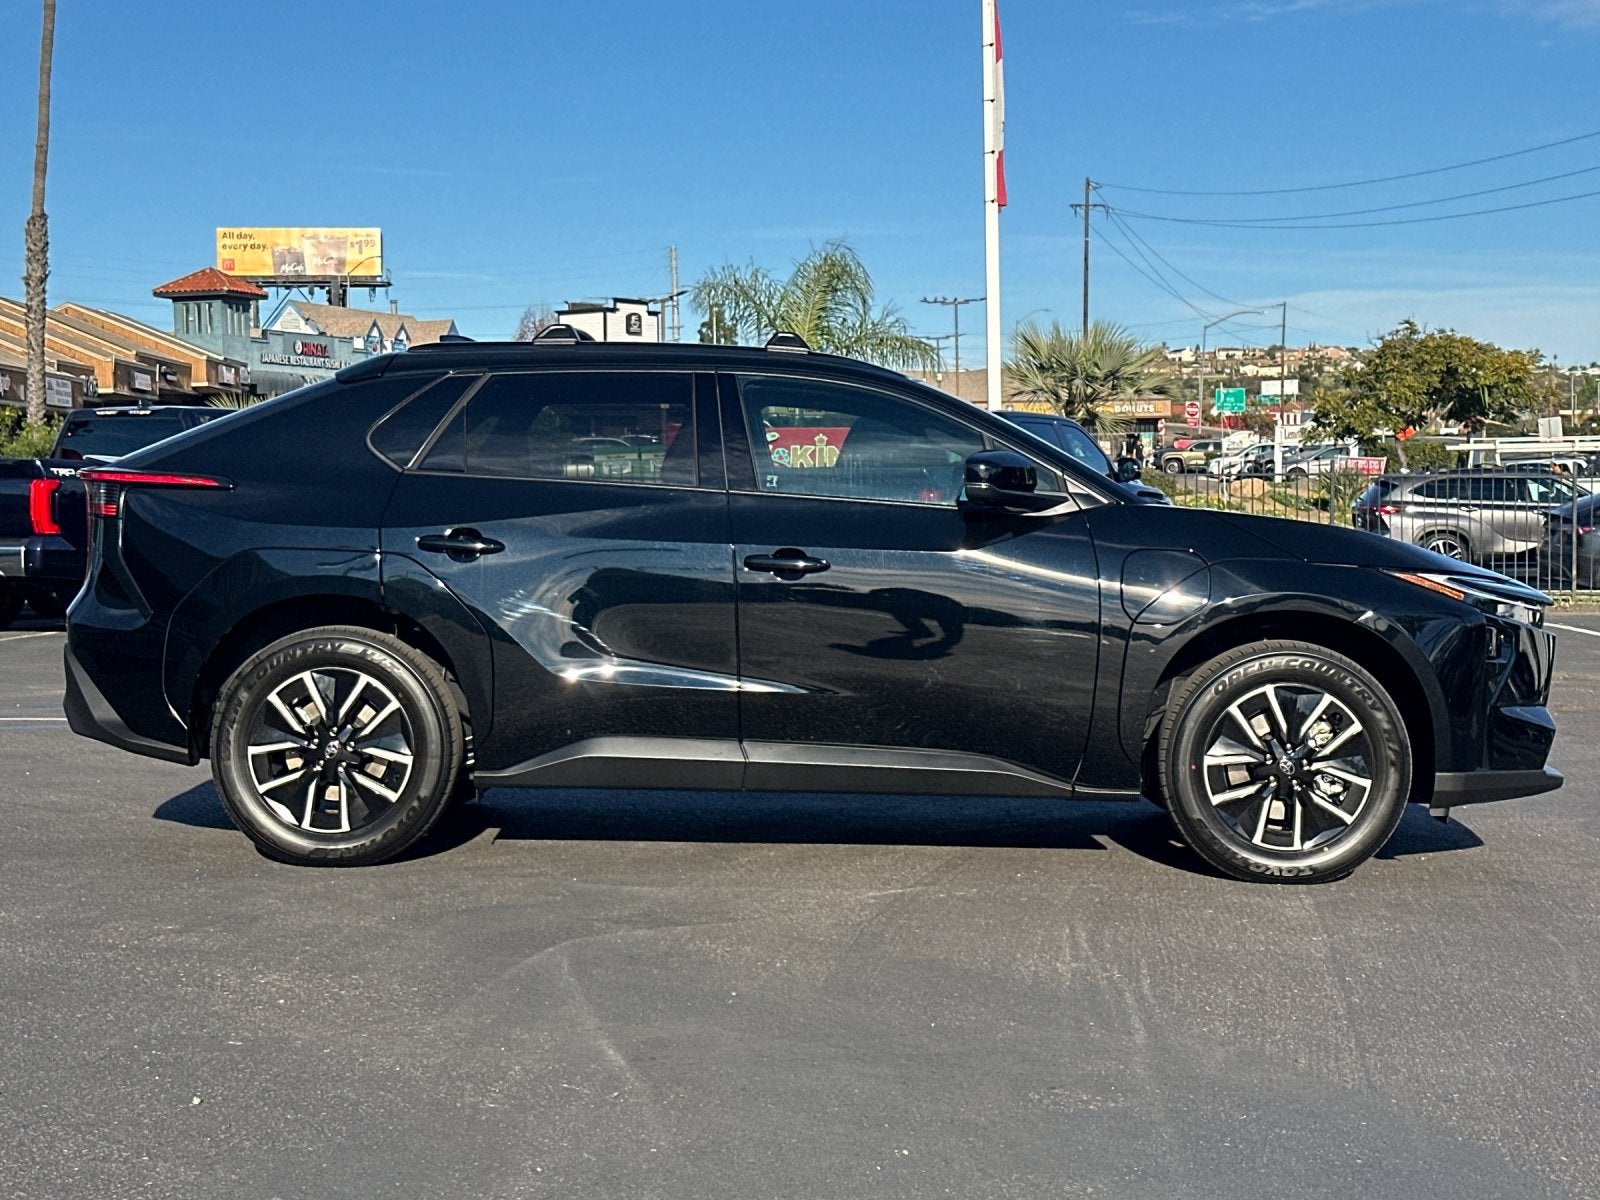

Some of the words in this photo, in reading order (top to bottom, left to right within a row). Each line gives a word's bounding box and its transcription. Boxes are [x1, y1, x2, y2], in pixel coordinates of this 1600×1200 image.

[222, 243, 248, 252] every
[250, 242, 268, 252] day.
[302, 342, 331, 357] HINATA
[261, 353, 289, 365] JAPANESE
[325, 358, 341, 369] SUSHI
[1114, 404, 1154, 413] DONUTS
[50, 467, 76, 477] TRD
[243, 642, 344, 692] COUNTRY
[1213, 657, 1274, 697] OPEN
[1282, 657, 1384, 713] COUNTRY
[1248, 862, 1315, 877] TOYO
